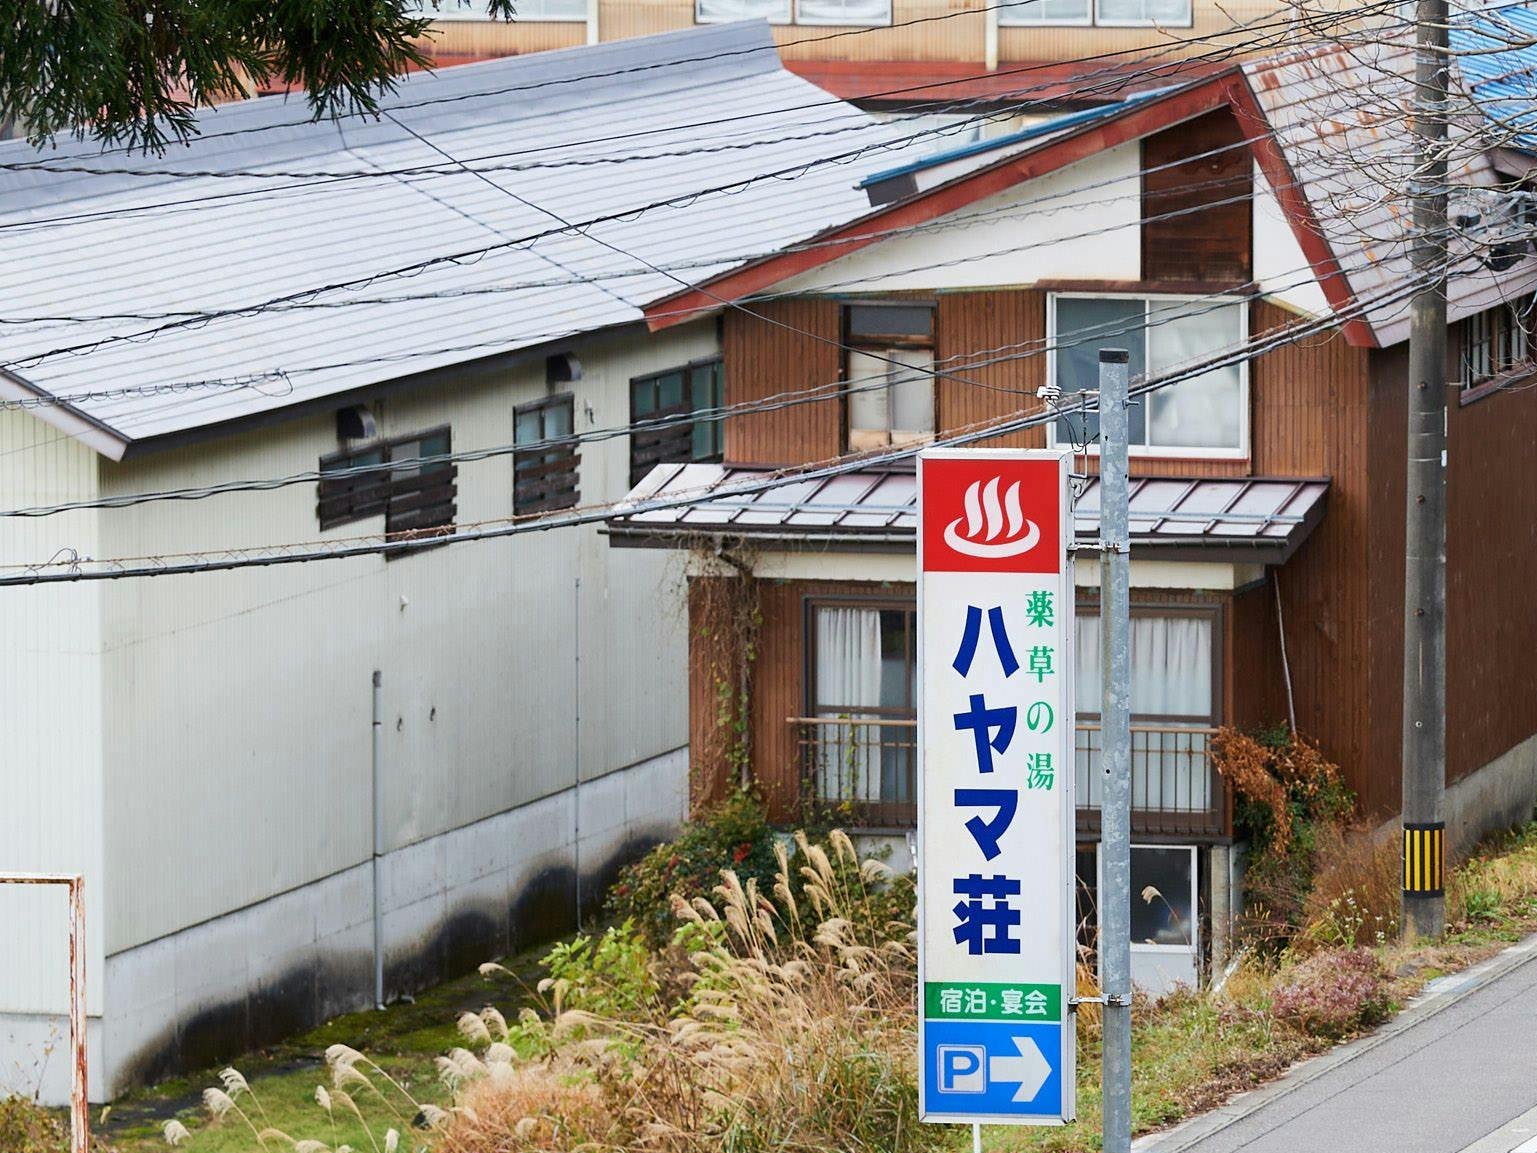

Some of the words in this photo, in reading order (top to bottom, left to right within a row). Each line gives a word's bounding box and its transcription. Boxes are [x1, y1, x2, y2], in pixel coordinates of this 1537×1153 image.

[1025, 590, 1055, 789] 薬草の湯
[952, 605, 1021, 955] ハヤマ荘
[940, 988, 1047, 1015] 宿泊・宴会
[944, 1051, 979, 1089] P
